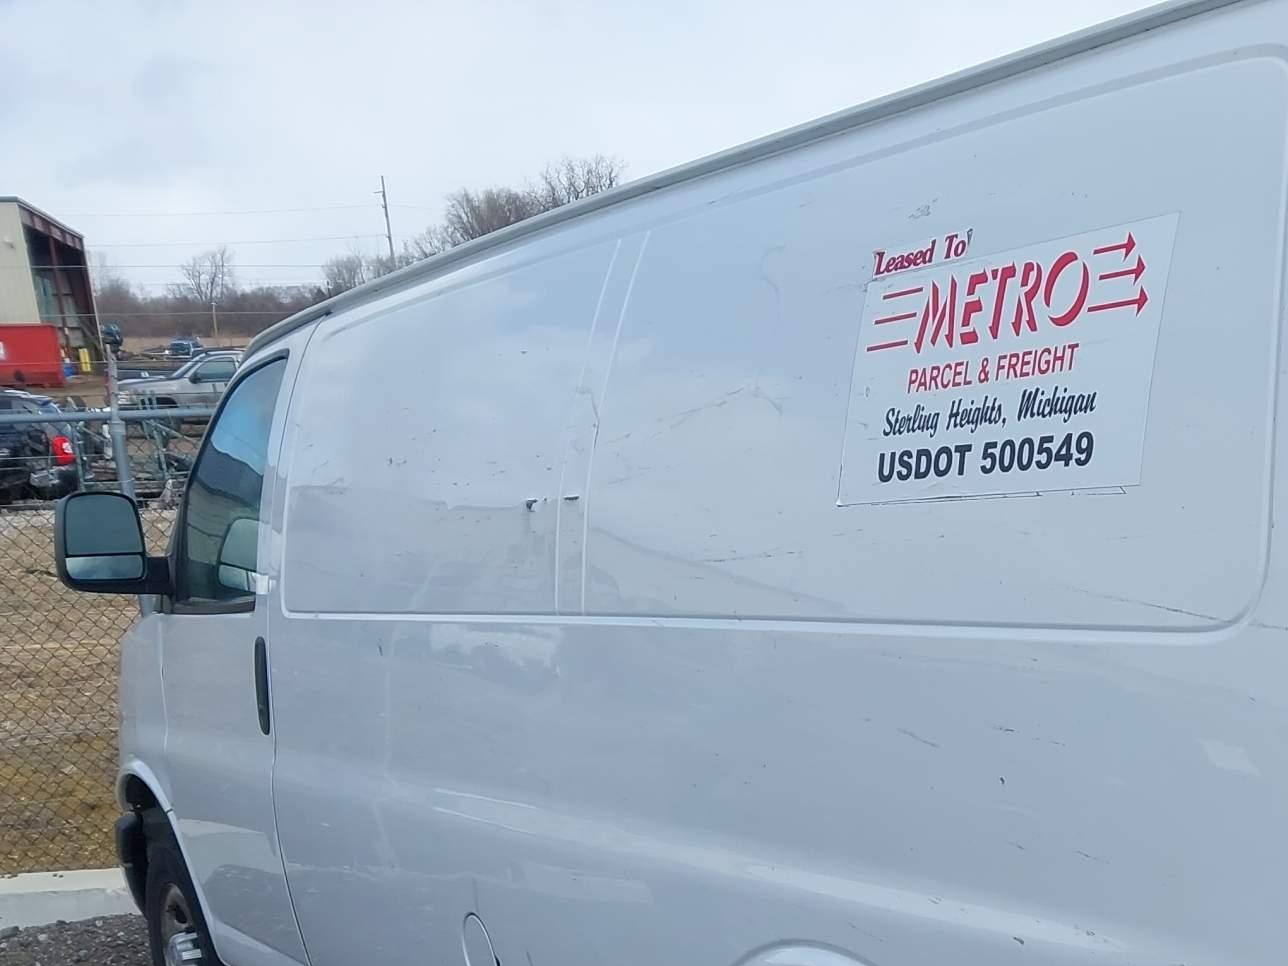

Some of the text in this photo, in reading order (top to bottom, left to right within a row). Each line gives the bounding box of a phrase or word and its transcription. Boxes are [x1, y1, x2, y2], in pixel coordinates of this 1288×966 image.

[873, 232, 968, 276] Leased To
[913, 251, 1090, 354] METRO
[907, 342, 1080, 394] PARCEL & FREIGHT
[882, 387, 1097, 437] Sterling Heights, Michigan
[877, 431, 1094, 483] USDOT 500549
